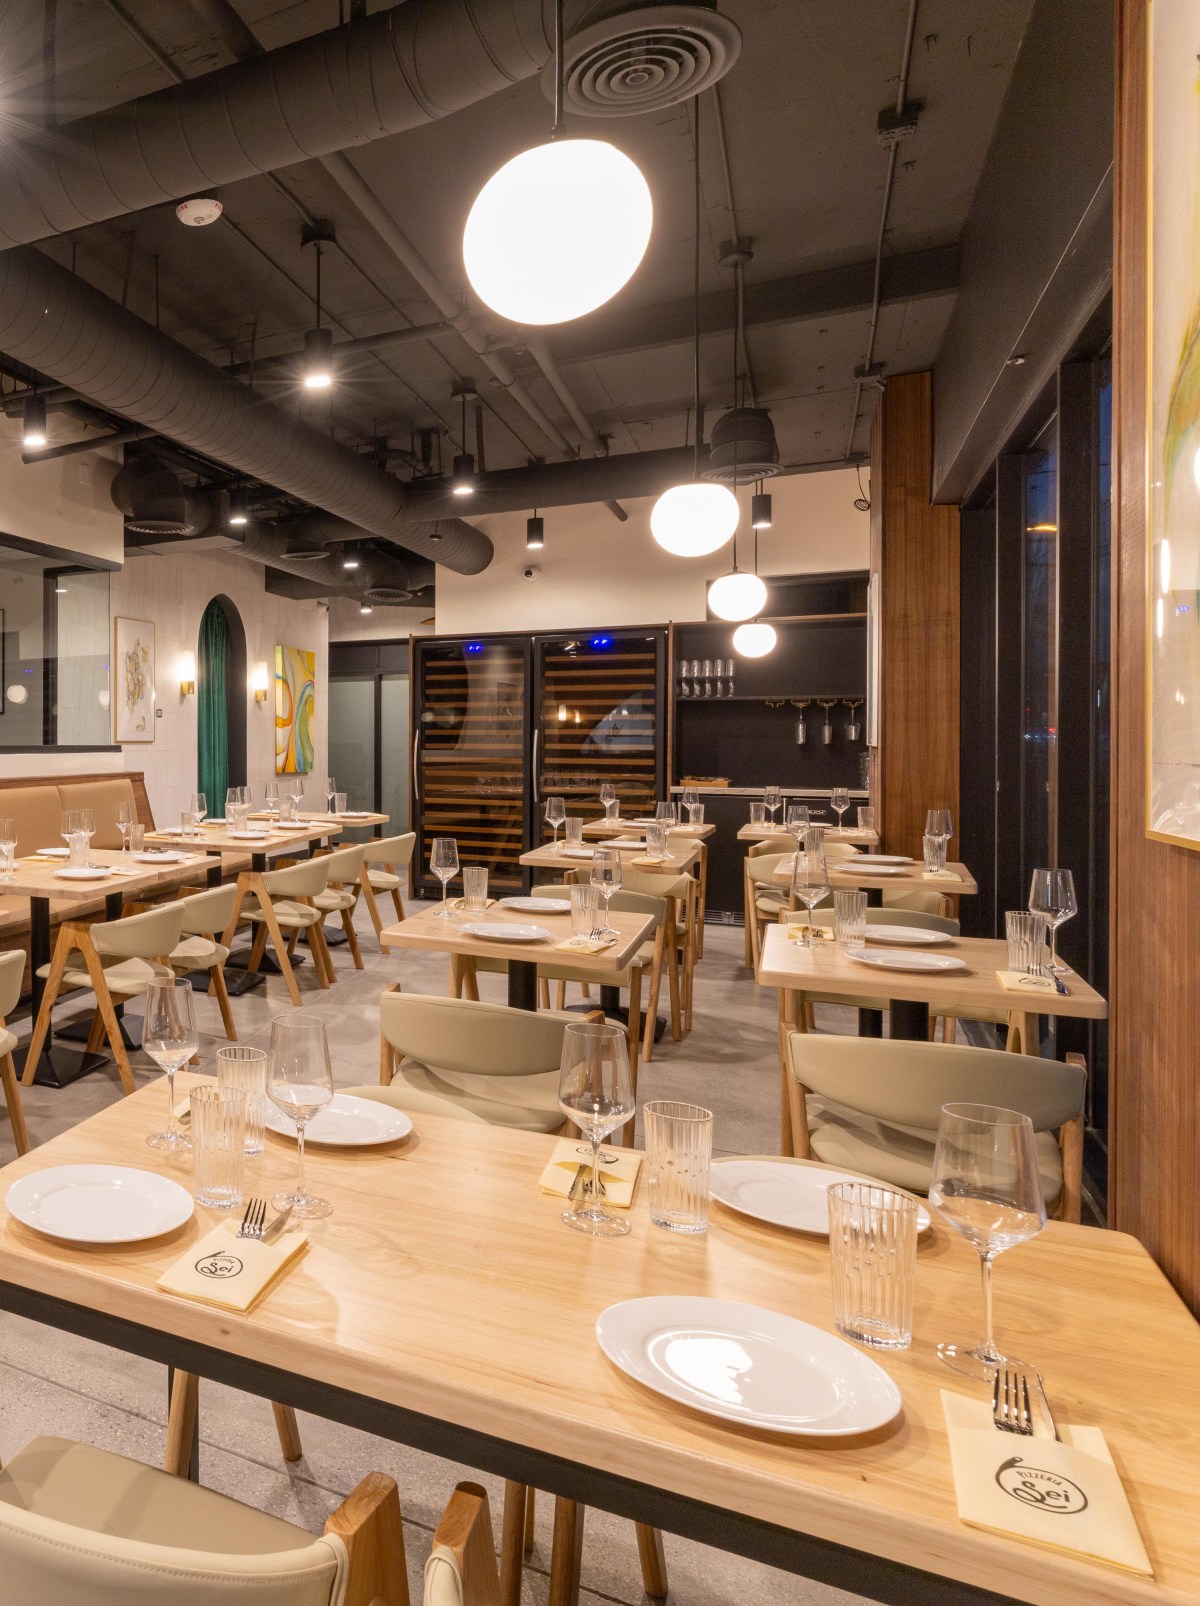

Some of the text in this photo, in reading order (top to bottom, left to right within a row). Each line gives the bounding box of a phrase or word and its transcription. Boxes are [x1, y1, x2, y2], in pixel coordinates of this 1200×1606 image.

[200, 1262, 235, 1276] Sei
[1016, 1471, 1062, 1486] PIZZERIA
[1012, 1480, 1070, 1509] Sei
